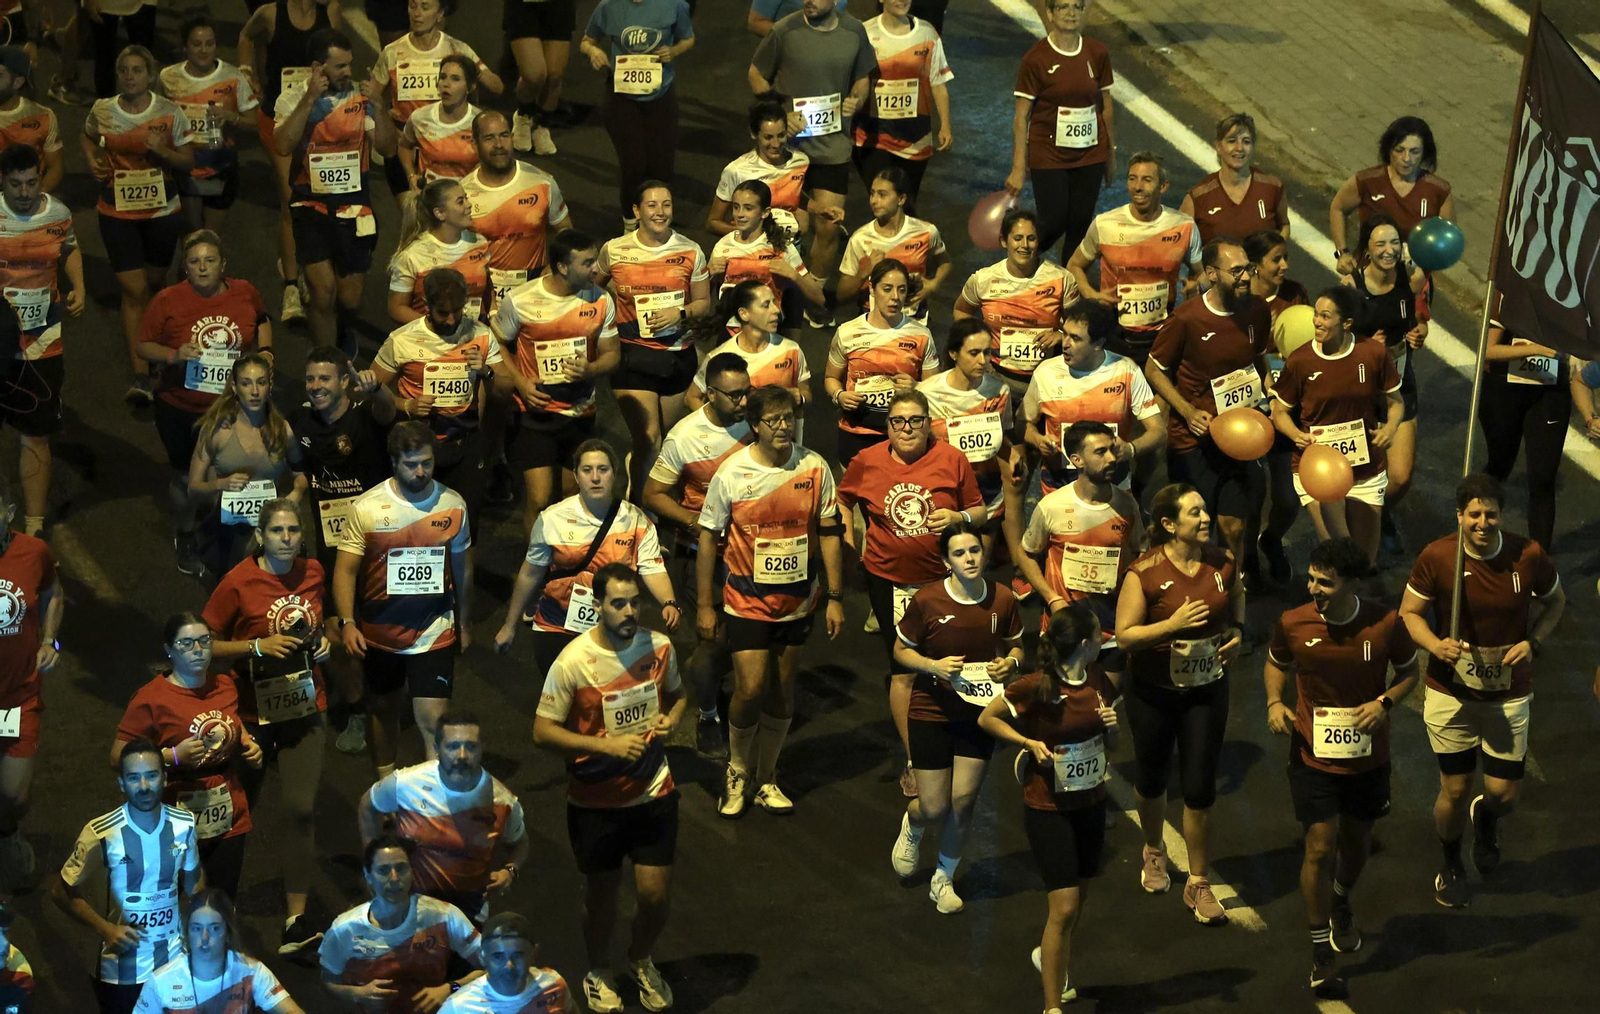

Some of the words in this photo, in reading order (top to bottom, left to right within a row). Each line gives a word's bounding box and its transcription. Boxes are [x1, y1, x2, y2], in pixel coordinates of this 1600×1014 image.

[629, 29, 648, 44] life
[623, 70, 652, 83] 2808
[876, 94, 912, 109] 11219
[808, 110, 835, 125] 1221
[1065, 123, 1093, 137] 2688
[319, 168, 350, 183] 9825
[120, 185, 158, 200] 12279
[1124, 298, 1162, 314] 21303
[192, 316, 230, 331] CARLOS
[230, 322, 238, 330] V
[1520, 358, 1550, 372] 2690
[430, 380, 469, 395] 15480
[1224, 385, 1253, 406] 2679
[959, 433, 992, 451] 6502
[1325, 440, 1357, 456] 664
[884, 483, 922, 503] CARLOS
[923, 489, 932, 498] V
[765, 556, 799, 572] 6268
[1081, 564, 1098, 580] 35
[397, 565, 433, 581] 6269
[15, 588, 24, 597] V
[267, 595, 303, 620] CARLOS
[303, 599, 311, 608] V
[1466, 663, 1502, 679] 2663
[962, 682, 994, 698] 2658
[264, 689, 309, 710] 17584
[615, 703, 648, 725] 9807
[189, 711, 223, 734] CARLOS
[1324, 728, 1361, 745] 2665
[1067, 758, 1099, 779] 2672
[129, 909, 173, 927] 24529
